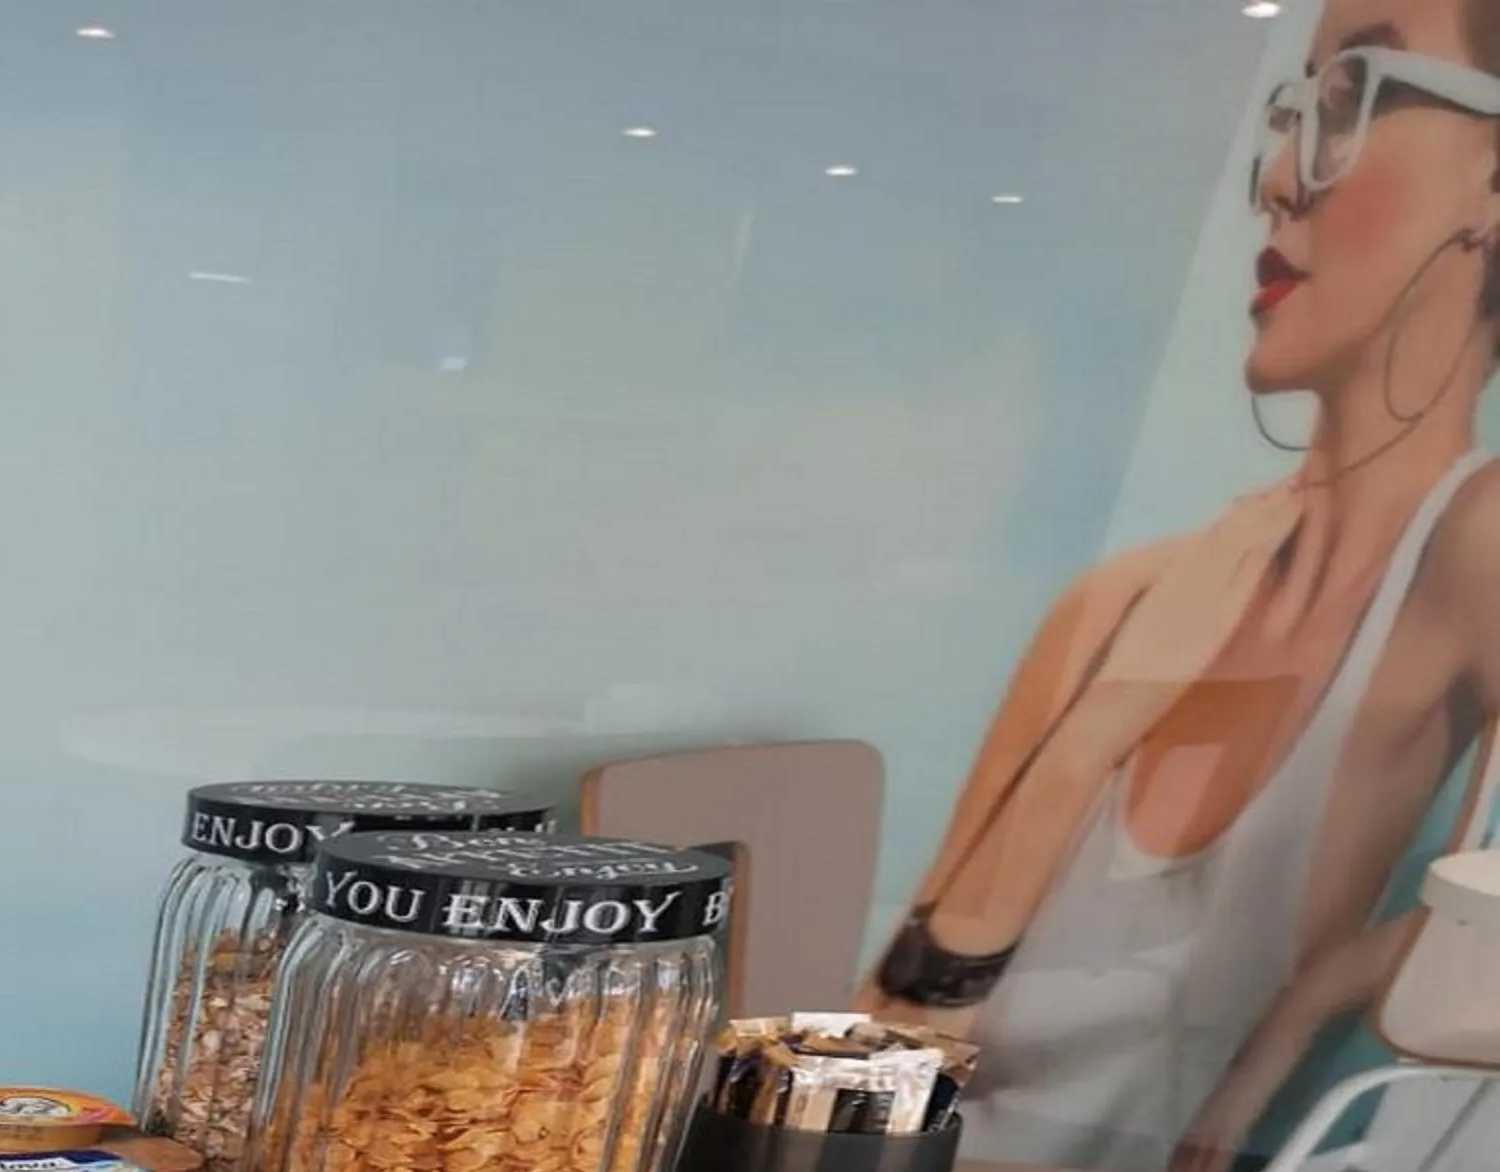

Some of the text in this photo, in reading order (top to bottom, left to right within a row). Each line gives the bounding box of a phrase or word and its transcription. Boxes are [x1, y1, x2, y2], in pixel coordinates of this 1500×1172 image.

[192, 812, 355, 854] ENJOY
[325, 871, 425, 923] YOU
[441, 890, 683, 935] ENJOY
